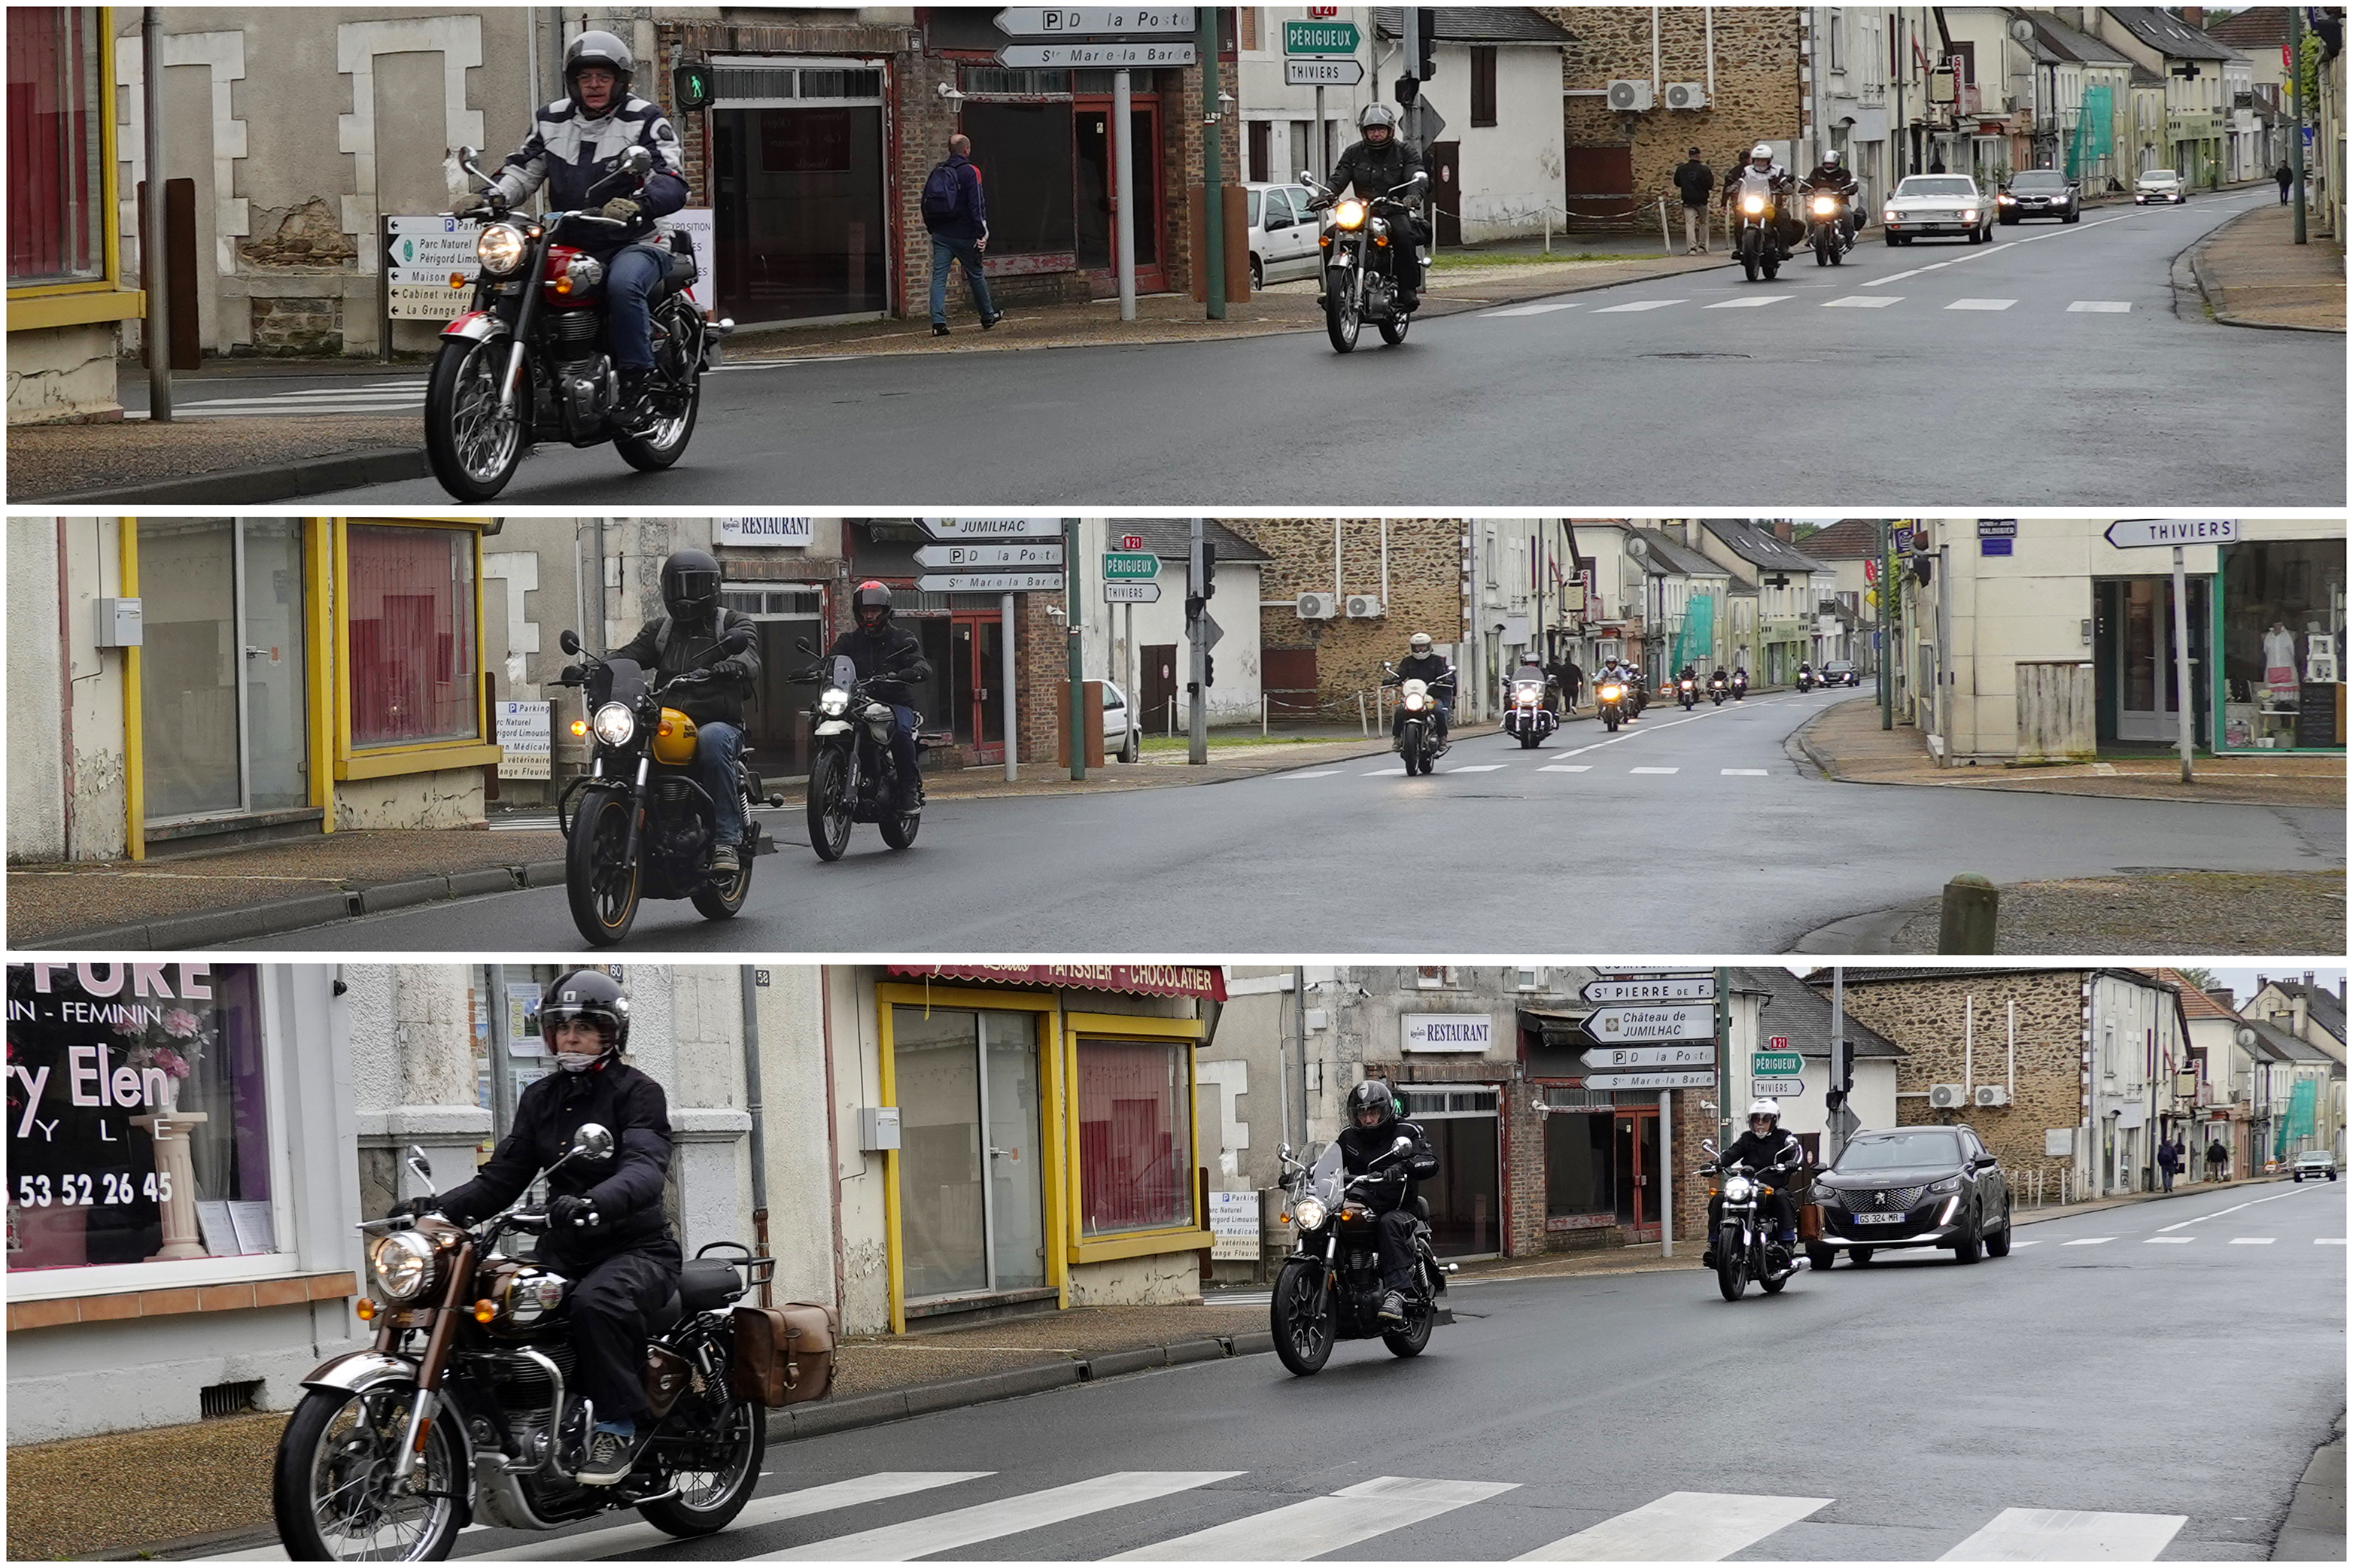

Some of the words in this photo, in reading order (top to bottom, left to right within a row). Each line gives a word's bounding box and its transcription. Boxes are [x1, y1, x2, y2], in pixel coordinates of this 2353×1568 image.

[1107, 13, 1123, 26] la
[1290, 26, 1351, 47] PÉRIGUEUX
[1292, 66, 1339, 78] THIVIERS
[458, 220, 482, 230] Park
[672, 223, 710, 231] POSITION
[420, 239, 438, 249] Parc
[441, 239, 471, 249] Naturel
[420, 254, 454, 266] Périgord
[458, 254, 480, 263] Limo
[412, 272, 445, 281] Maison
[403, 289, 438, 299] Cabinet
[444, 290, 474, 299] vétéri
[407, 305, 416, 315] La
[422, 305, 455, 318] Grange
[741, 518, 810, 535] RESTAURANT
[961, 520, 1025, 533] JUMILHAC
[2149, 521, 2230, 539] THIVIERS
[1126, 538, 1130, 548] N
[1132, 538, 1140, 548] 21
[998, 550, 1009, 561] la
[1108, 558, 1152, 572] PÉRIGUEUX
[970, 577, 1018, 587] Mare-la
[1027, 576, 1059, 586] Bare
[1108, 588, 1143, 597] THIVIERS
[519, 704, 550, 713] Parking
[497, 729, 517, 738] rigord
[514, 743, 550, 751] Médicale
[522, 767, 550, 776] Fleurie
[610, 965, 622, 977] 60
[758, 971, 768, 983] 58
[1131, 965, 1212, 991] CHOCOLATIER
[1616, 986, 1669, 998] PIERRE
[1698, 985, 1710, 995] F.
[62, 1001, 162, 1025] FEMININ
[1623, 1012, 1667, 1023] Château
[1674, 1011, 1686, 1021] de
[1427, 1024, 1488, 1041] RESTAURANT
[1623, 1025, 1681, 1037] JUMILHAC
[1773, 1039, 1777, 1047] N
[1778, 1038, 1786, 1047] 21
[1656, 1052, 1667, 1062] la
[1756, 1056, 1796, 1070] PÉRIGUEUX
[68, 1043, 169, 1108] Elen
[1631, 1076, 1674, 1086] Mare-la
[1683, 1075, 1712, 1083] Bare
[1757, 1083, 1788, 1092] THIVIERS
[20, 1174, 52, 1208] 53
[62, 1173, 94, 1206] 52
[102, 1172, 134, 1205] 26
[143, 1171, 172, 1202] 45
